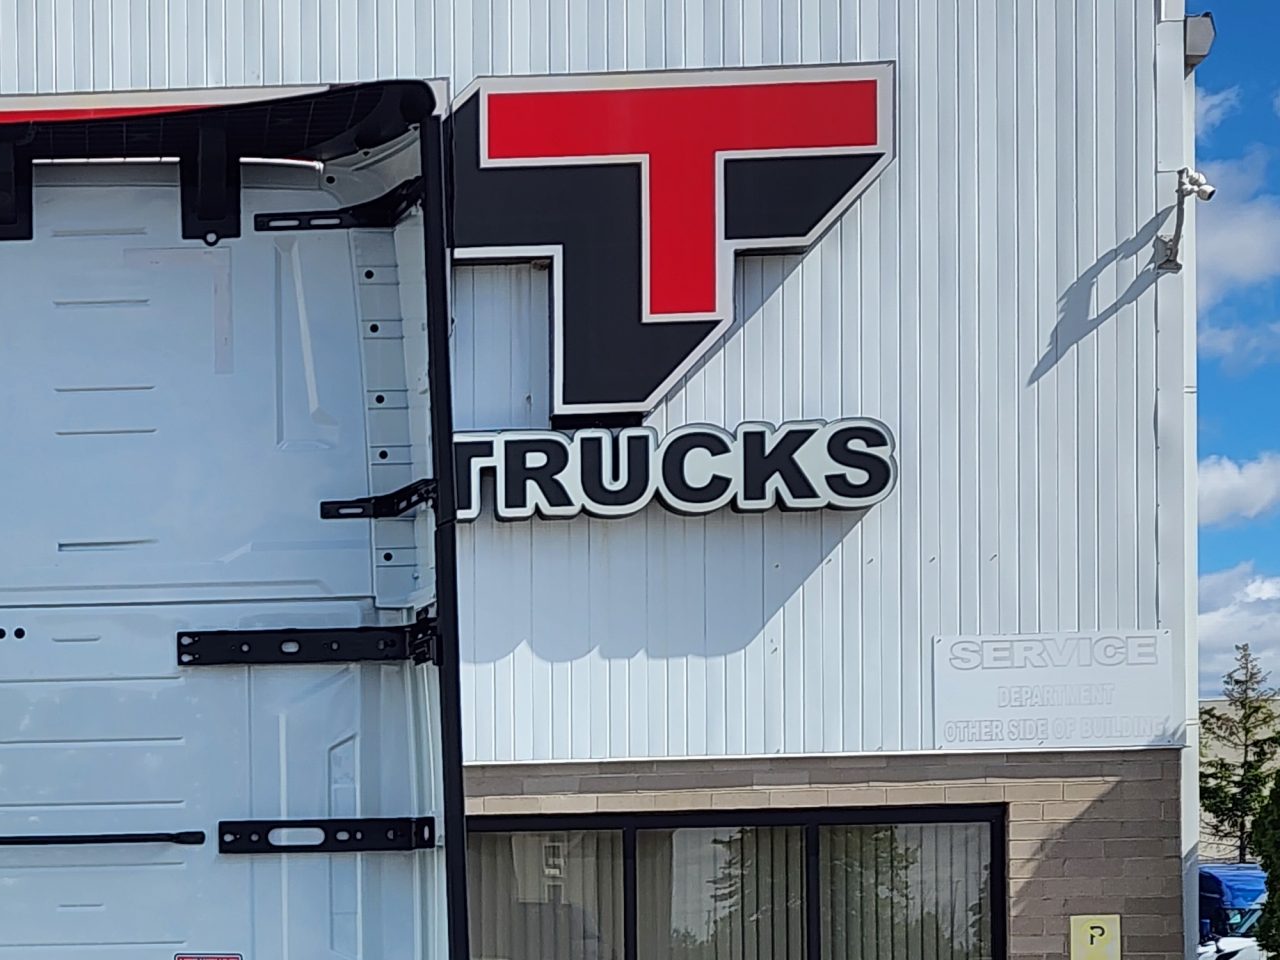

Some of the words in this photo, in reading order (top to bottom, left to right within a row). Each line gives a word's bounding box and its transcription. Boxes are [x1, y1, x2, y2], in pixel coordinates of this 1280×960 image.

[453, 424, 893, 512] TRUCKS
[949, 636, 1157, 670] SERVICE
[998, 683, 1115, 708] DEPARTMENT
[944, 719, 1004, 742] OTHER
[1007, 718, 1048, 741] SIDE
[1054, 717, 1076, 739] OF
